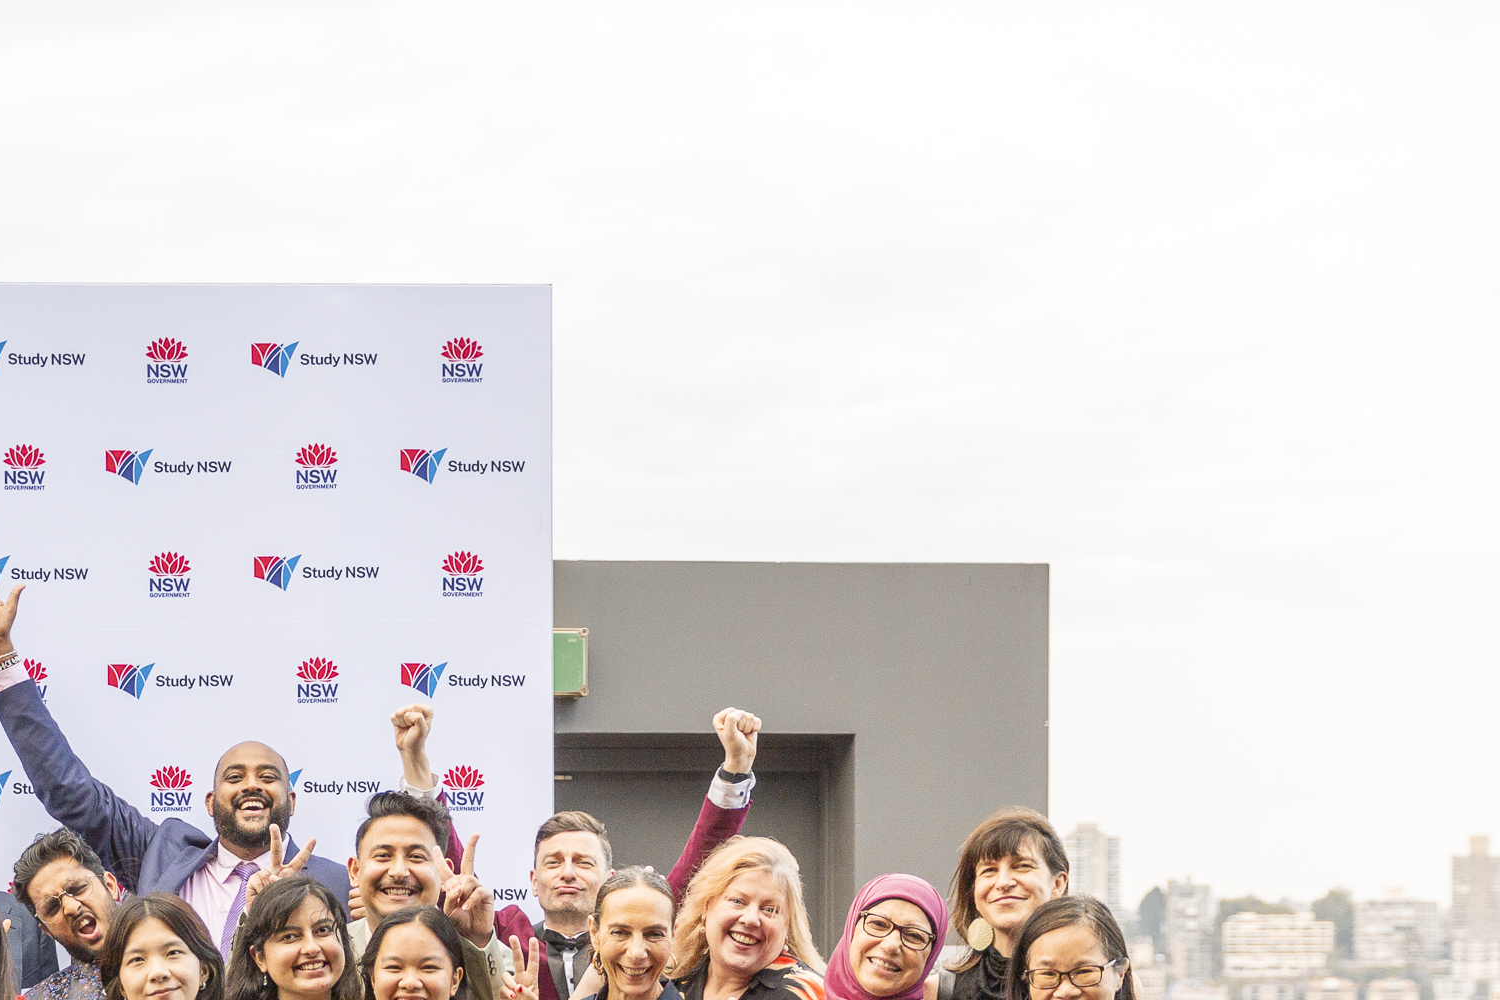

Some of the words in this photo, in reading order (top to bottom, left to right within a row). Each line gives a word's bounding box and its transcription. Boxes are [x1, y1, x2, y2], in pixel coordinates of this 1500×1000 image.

[7, 352, 49, 368] Study
[50, 353, 86, 366] NSW
[299, 352, 341, 368] Study
[343, 353, 378, 366] NSW
[146, 363, 189, 379] NSW
[441, 362, 484, 378] NSW
[153, 460, 195, 476] Study
[196, 460, 232, 474] NSW
[447, 459, 489, 475] Study
[490, 460, 526, 473] NSW
[4, 470, 46, 485] NSW
[295, 469, 338, 484] NSW
[10, 567, 52, 583] Study
[53, 567, 89, 581] NSW
[302, 565, 343, 581] Study
[345, 566, 380, 579] NSW
[149, 577, 191, 593] NSW
[442, 576, 484, 592] NSW
[155, 674, 196, 690] Study
[198, 674, 234, 687] NSW
[448, 674, 489, 690] Study
[491, 674, 526, 687] NSW
[297, 683, 339, 698] NSW
[12, 782, 35, 795] Stu
[303, 780, 344, 796] Study
[346, 780, 381, 793] NSW
[150, 791, 193, 807] NSW
[444, 791, 484, 806] NSW
[492, 888, 528, 901] NSW
